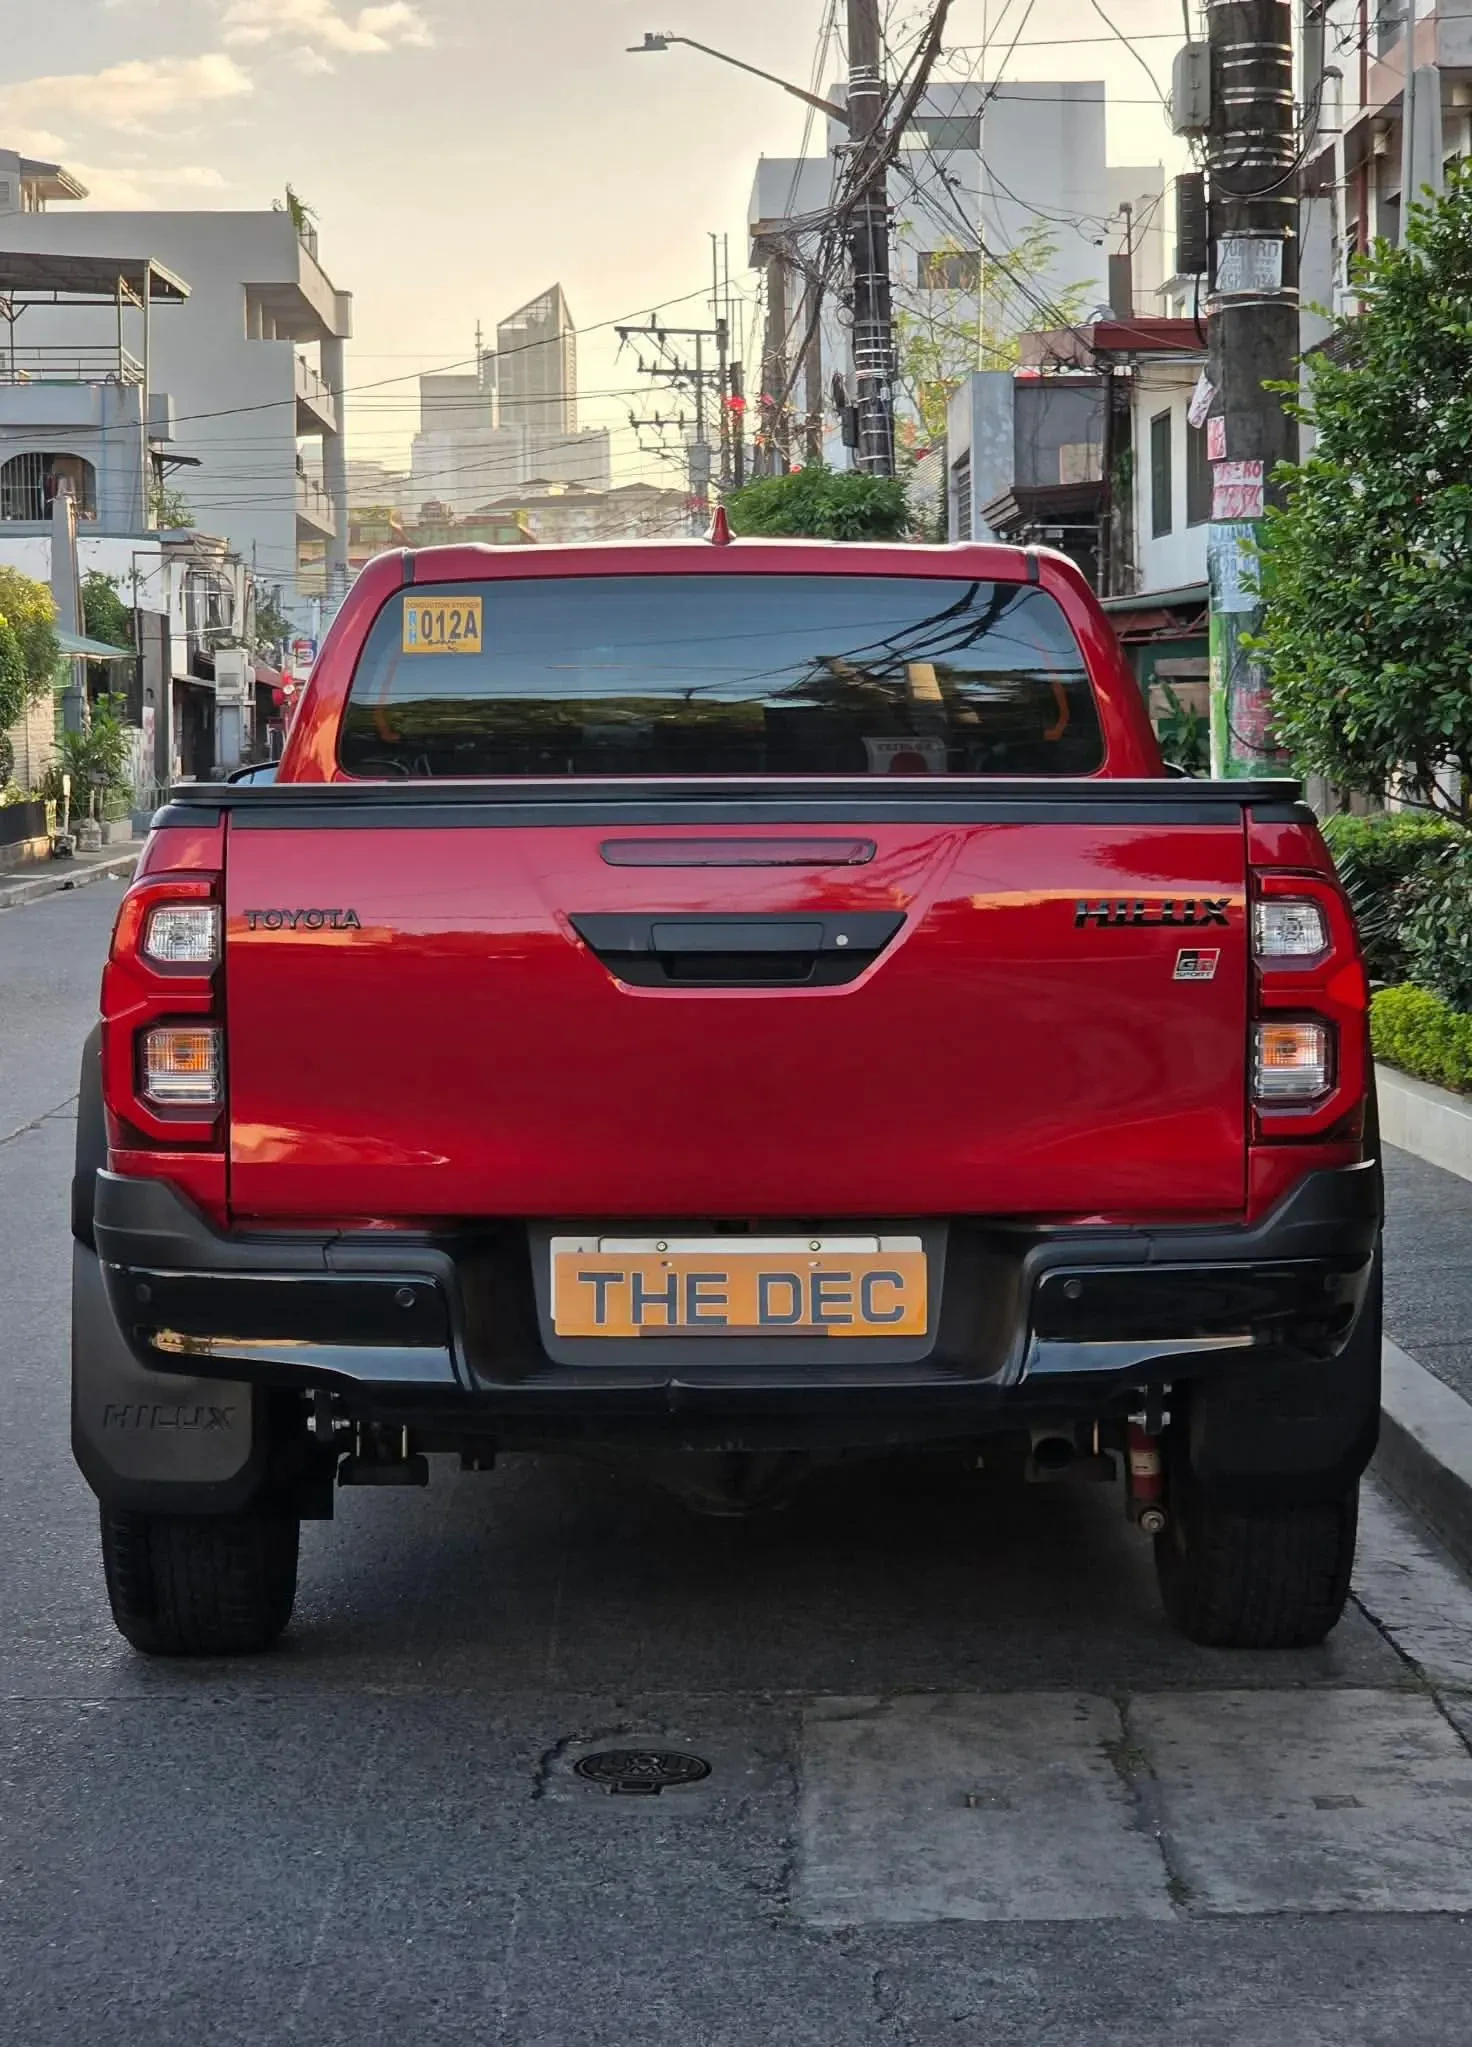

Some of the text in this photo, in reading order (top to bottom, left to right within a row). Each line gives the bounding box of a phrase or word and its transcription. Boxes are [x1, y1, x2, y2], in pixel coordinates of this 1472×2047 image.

[421, 610, 478, 640] 012A
[243, 908, 362, 931] TOYOTA
[1073, 898, 1232, 928] HILUX
[1177, 957, 1215, 972] GR
[577, 1270, 905, 1326] THE DEC
[102, 1403, 237, 1431] HILUX
